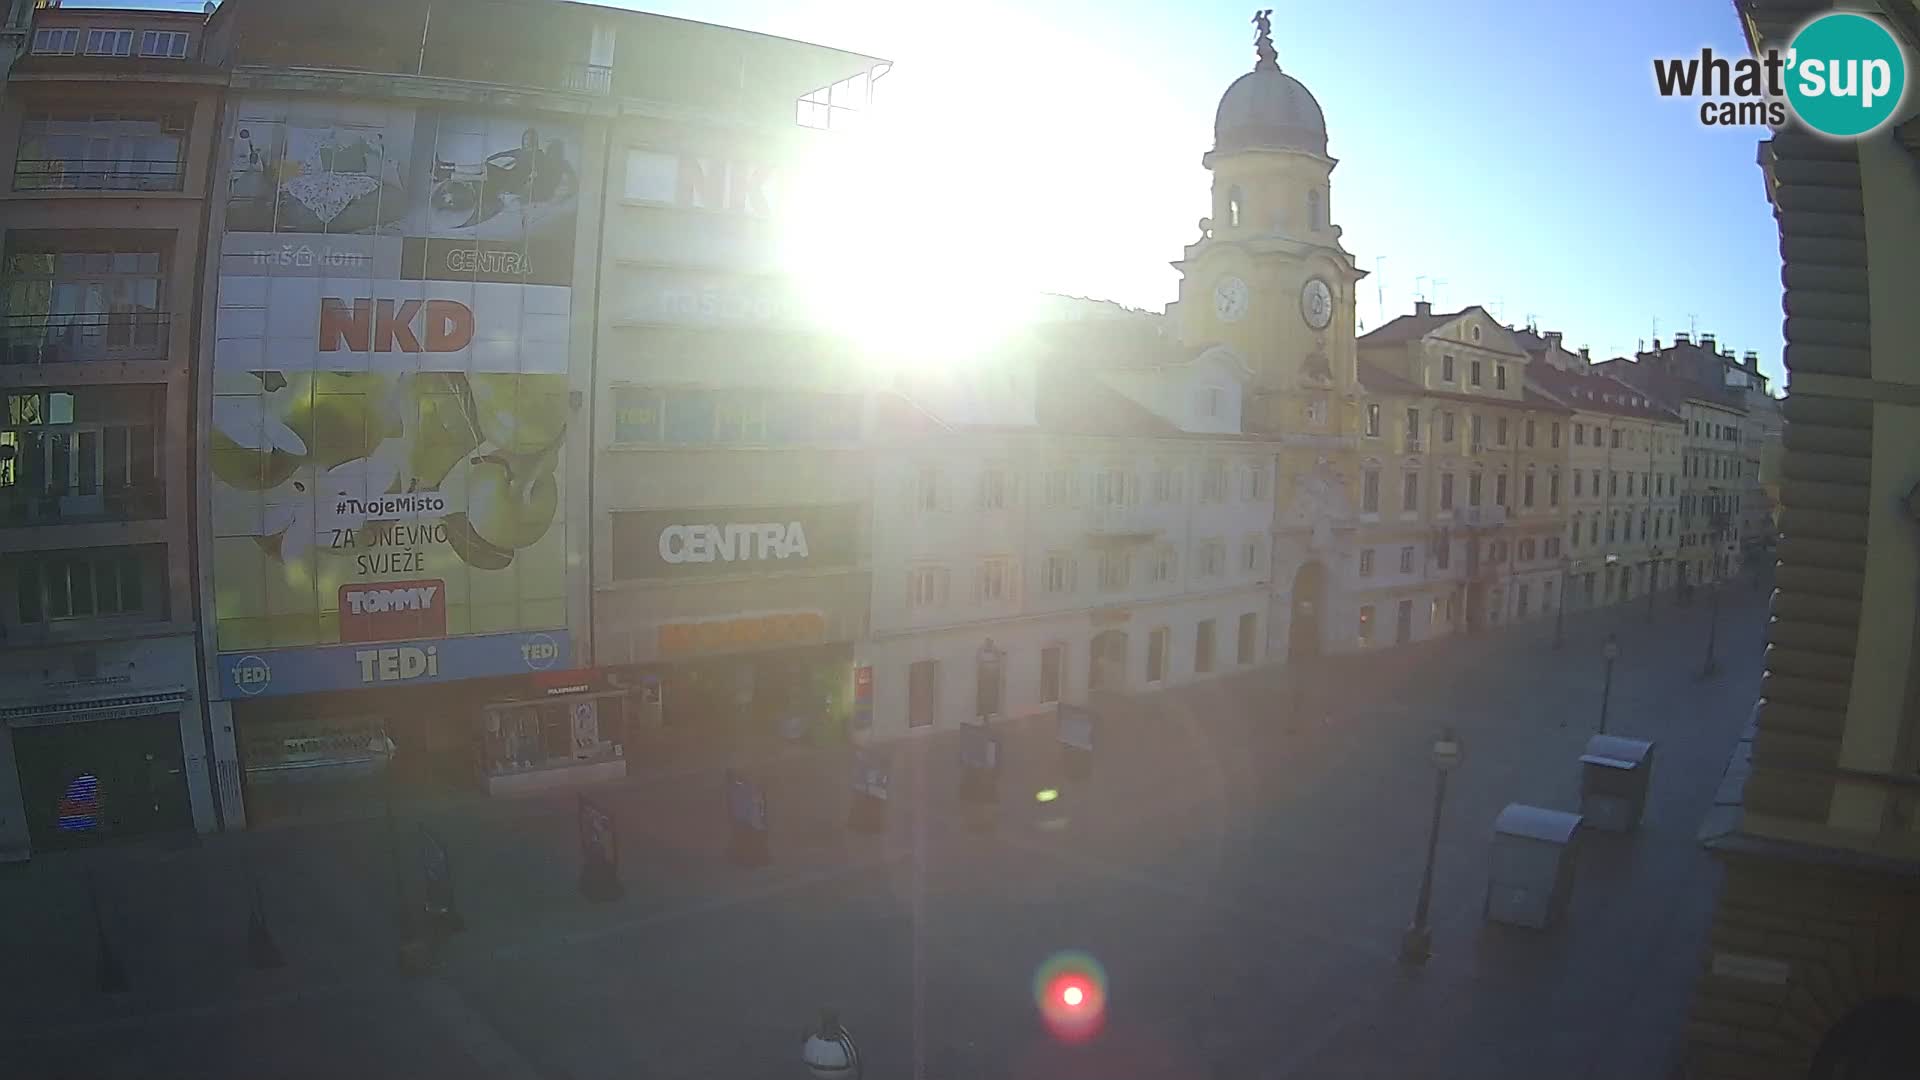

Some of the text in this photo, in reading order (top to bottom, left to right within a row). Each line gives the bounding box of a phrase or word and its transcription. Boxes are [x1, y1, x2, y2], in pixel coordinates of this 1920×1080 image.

[446, 248, 534, 274] CENTRA
[319, 297, 475, 353] NKD
[336, 496, 445, 516] #TvojeMisto
[331, 528, 356, 549] ZA
[658, 521, 808, 564] CENTRA
[357, 547, 425, 575] SVJEŽE
[347, 587, 437, 615] TOMMY
[232, 666, 271, 686] TEDi
[355, 645, 437, 684] TEDi
